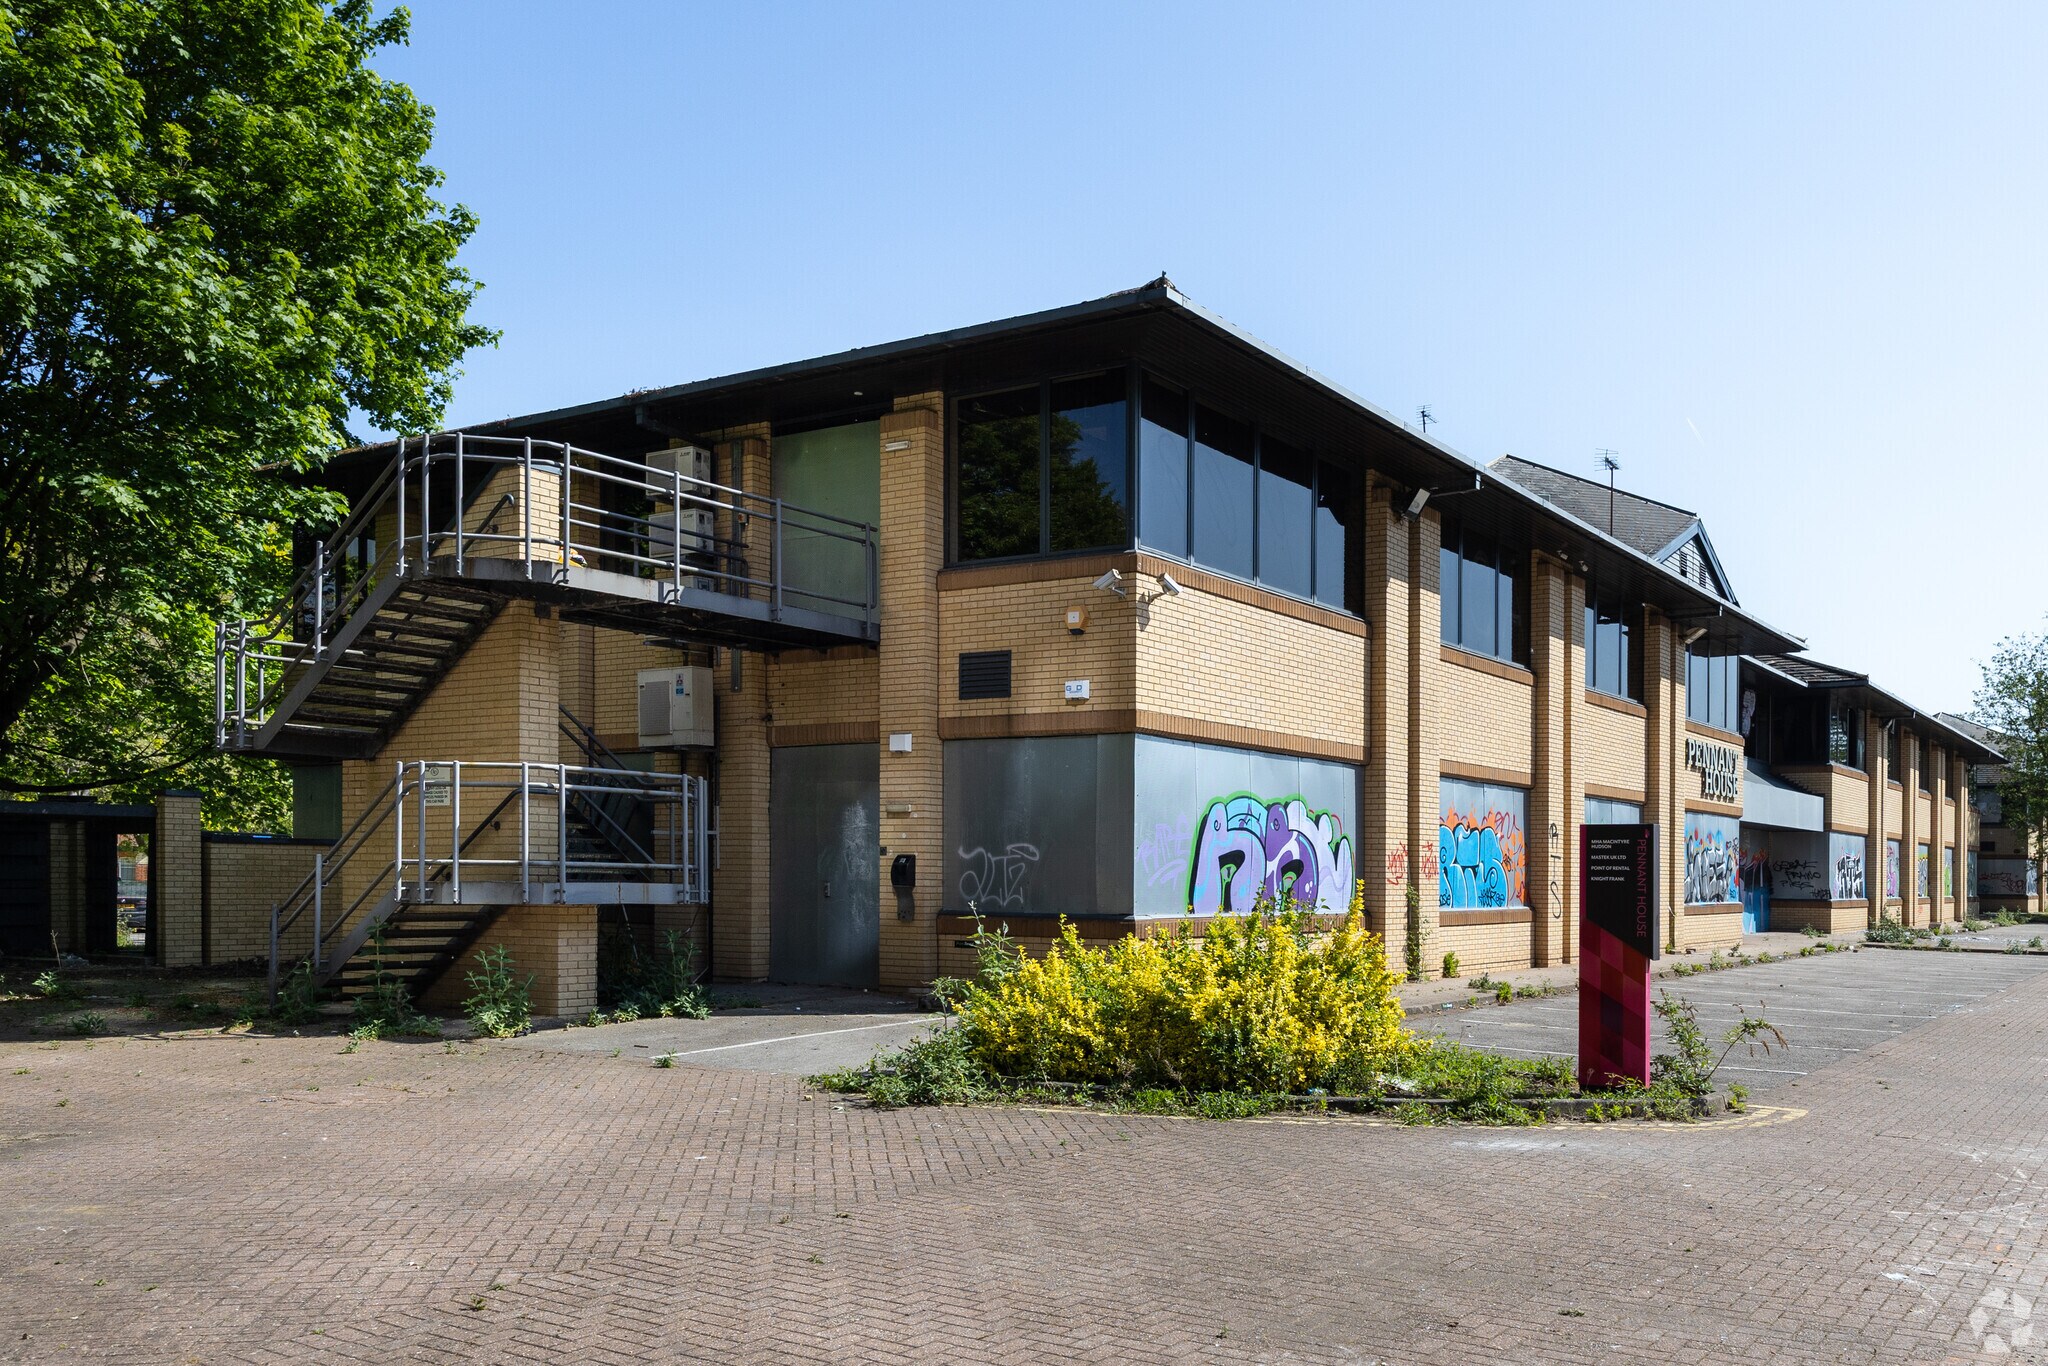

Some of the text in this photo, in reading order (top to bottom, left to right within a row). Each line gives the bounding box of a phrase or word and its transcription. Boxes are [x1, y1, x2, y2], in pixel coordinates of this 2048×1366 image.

[1687, 738, 1739, 774] PENNANT
[1705, 767, 1738, 798] HOUSE
[1637, 839, 1647, 894] PENNANT
[1637, 896, 1647, 937] HOUSE
